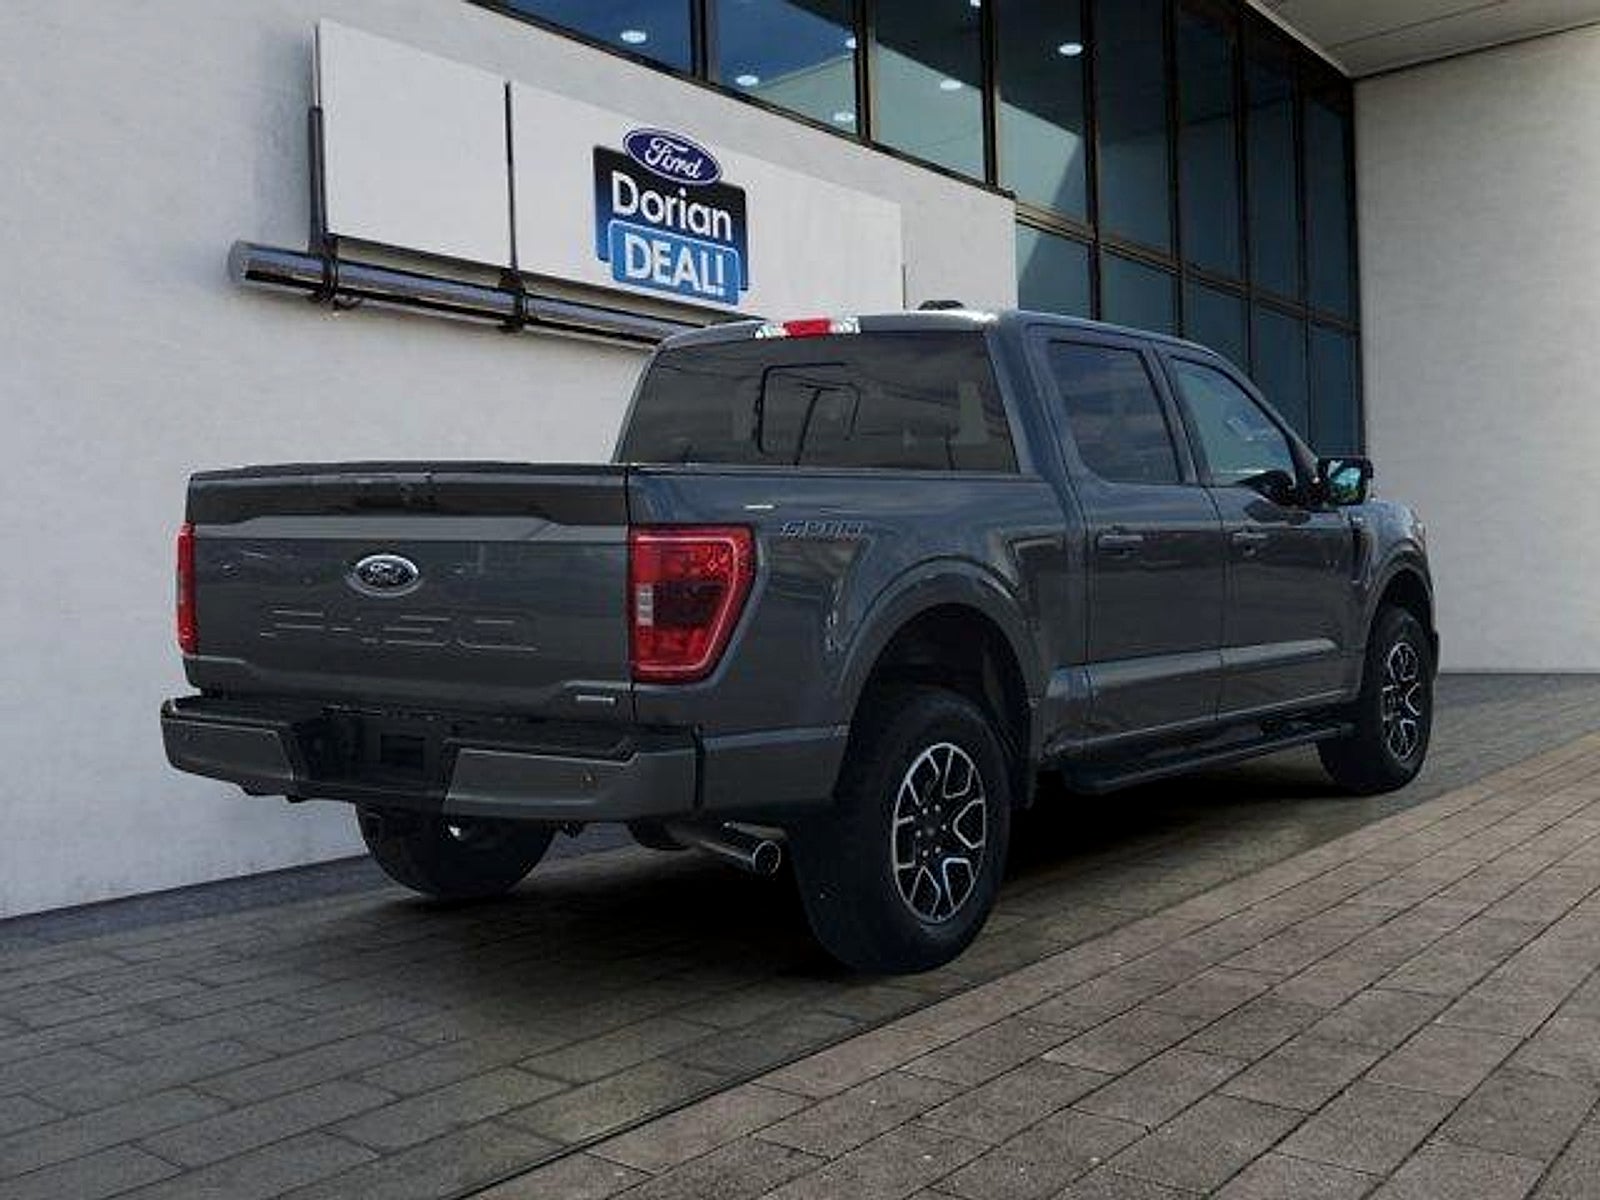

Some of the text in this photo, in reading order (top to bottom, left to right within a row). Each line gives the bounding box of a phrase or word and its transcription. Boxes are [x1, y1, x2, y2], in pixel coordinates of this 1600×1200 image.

[645, 137, 703, 179] Ford
[612, 170, 732, 241] Dorian
[625, 232, 724, 296] DEAL!
